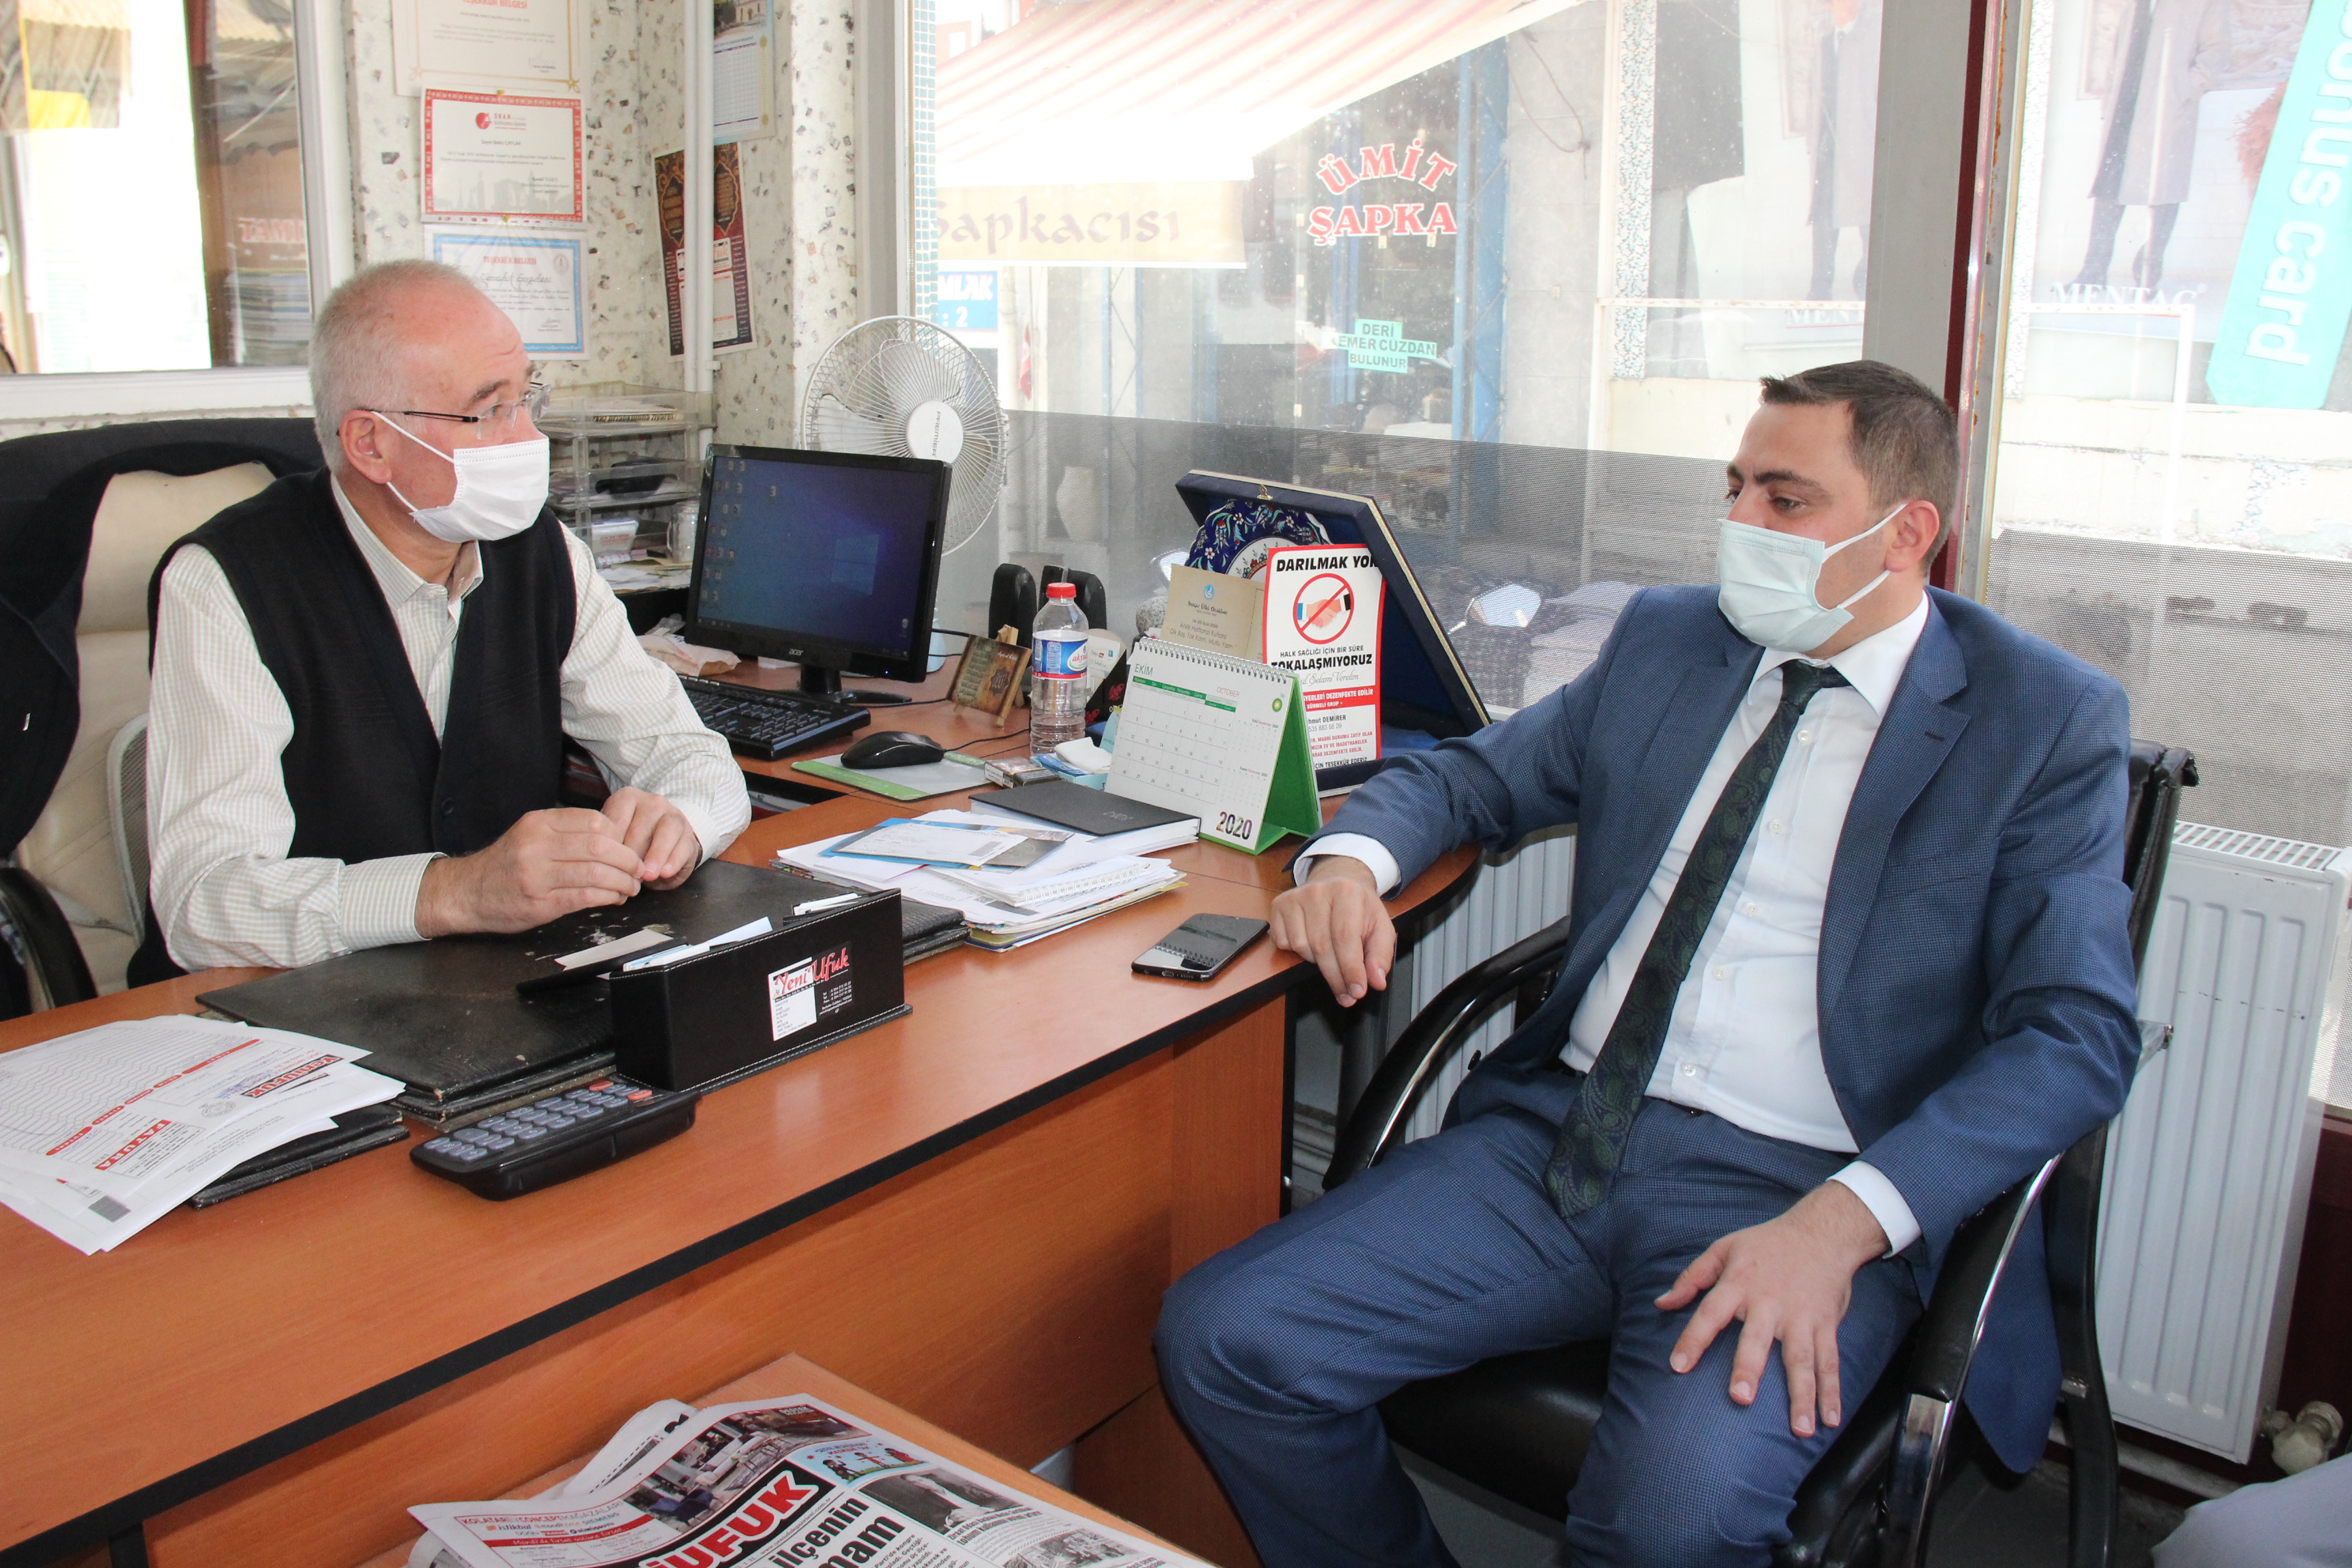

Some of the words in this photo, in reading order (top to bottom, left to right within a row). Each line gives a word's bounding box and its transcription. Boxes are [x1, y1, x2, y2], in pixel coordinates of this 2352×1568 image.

[1316, 137, 1457, 195] ÜMİT
[1306, 202, 1457, 246] ŞAPKA
[2243, 220, 2326, 365] card
[956, 306, 968, 327] 2
[1362, 323, 1394, 337] DERİ
[1379, 338, 1436, 355] CÜZDAN
[1350, 353, 1407, 368] BULUNUR
[1276, 556, 1348, 572] DARILMAK
[1298, 647, 1321, 656] SAĞLIĞI
[1322, 646, 1335, 655] İÇİN
[1337, 644, 1348, 653] BİR
[1134, 663, 1154, 676] EKİM
[1333, 670, 1358, 682] Verelim
[1216, 687, 1240, 698] OCTOBER
[1326, 689, 1356, 699] DEZENFEKTE
[1358, 688, 1373, 696] EDİLİR
[1322, 714, 1346, 723] DEMİRER
[1336, 739, 1367, 747] İBADETHANELER
[1324, 748, 1348, 756] DEZENFEKTE
[1216, 811, 1253, 840] 2020
[774, 968, 808, 995] Yeni
[808, 947, 850, 981] Ufuk
[244, 1056, 340, 1097] YeniUFUK
[99, 1122, 165, 1169] FATURA
[896, 1533, 915, 1551] kongre
